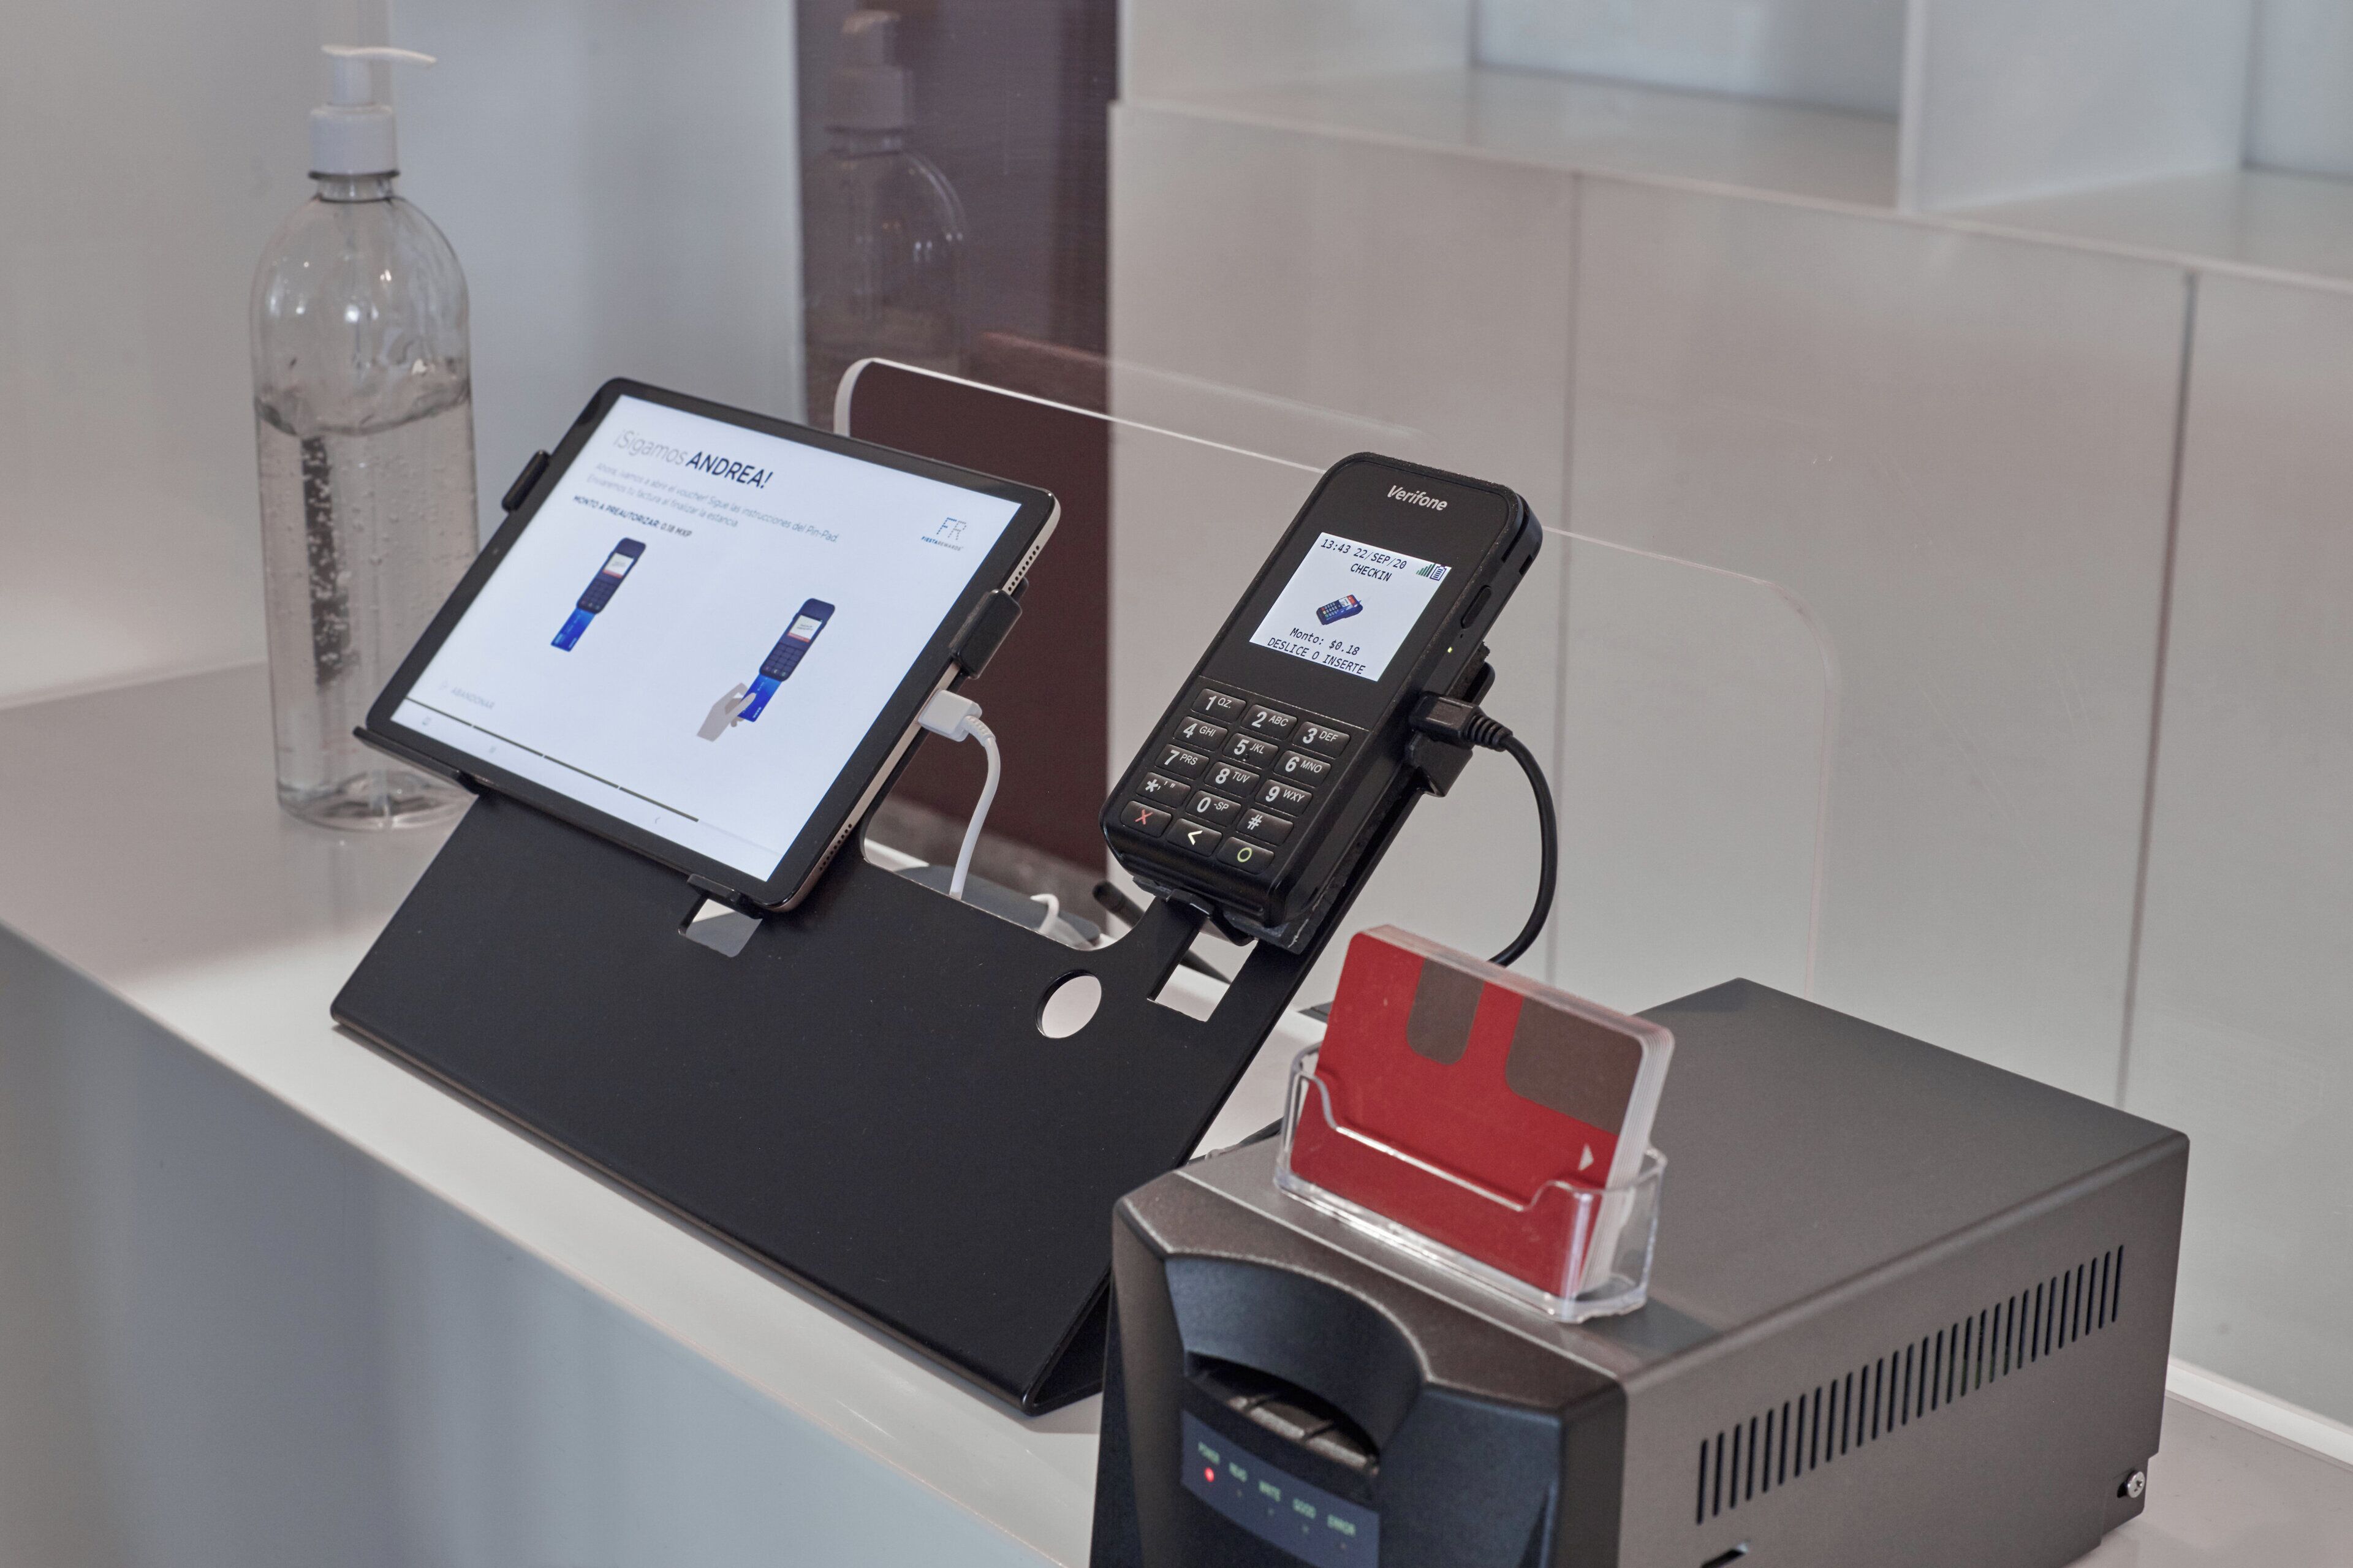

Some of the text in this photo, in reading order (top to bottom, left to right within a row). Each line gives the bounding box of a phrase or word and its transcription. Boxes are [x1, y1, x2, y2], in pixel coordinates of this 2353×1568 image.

[686, 451, 773, 488] ANDREA!
[1387, 485, 1448, 512] Verifone
[574, 494, 599, 508] MONTO
[675, 527, 692, 537] MXP
[707, 496, 729, 509] Sigue
[743, 507, 790, 528] instrucciones
[792, 523, 806, 532] del
[1320, 539, 1407, 570] 13:43 22/SEP/20
[1350, 563, 1392, 582] CHECKIN
[1290, 627, 1360, 656] Monto: $0.18
[1267, 637, 1309, 656] DESLICE
[1322, 654, 1365, 675] INSERTE
[1206, 695, 1216, 710] 1
[1251, 711, 1289, 728] 2 ABC
[1183, 724, 1216, 738] 4 GHI
[1303, 728, 1338, 744] 3 DEF
[1233, 739, 1264, 755] 5 JKL
[1164, 749, 1198, 765] 7 PRS
[1285, 756, 1322, 773] 6 MNO
[1215, 768, 1249, 784] 8 TUV
[1265, 786, 1304, 803] 9 WXY
[1197, 797, 1210, 812] 0
[1248, 815, 1262, 830] #
